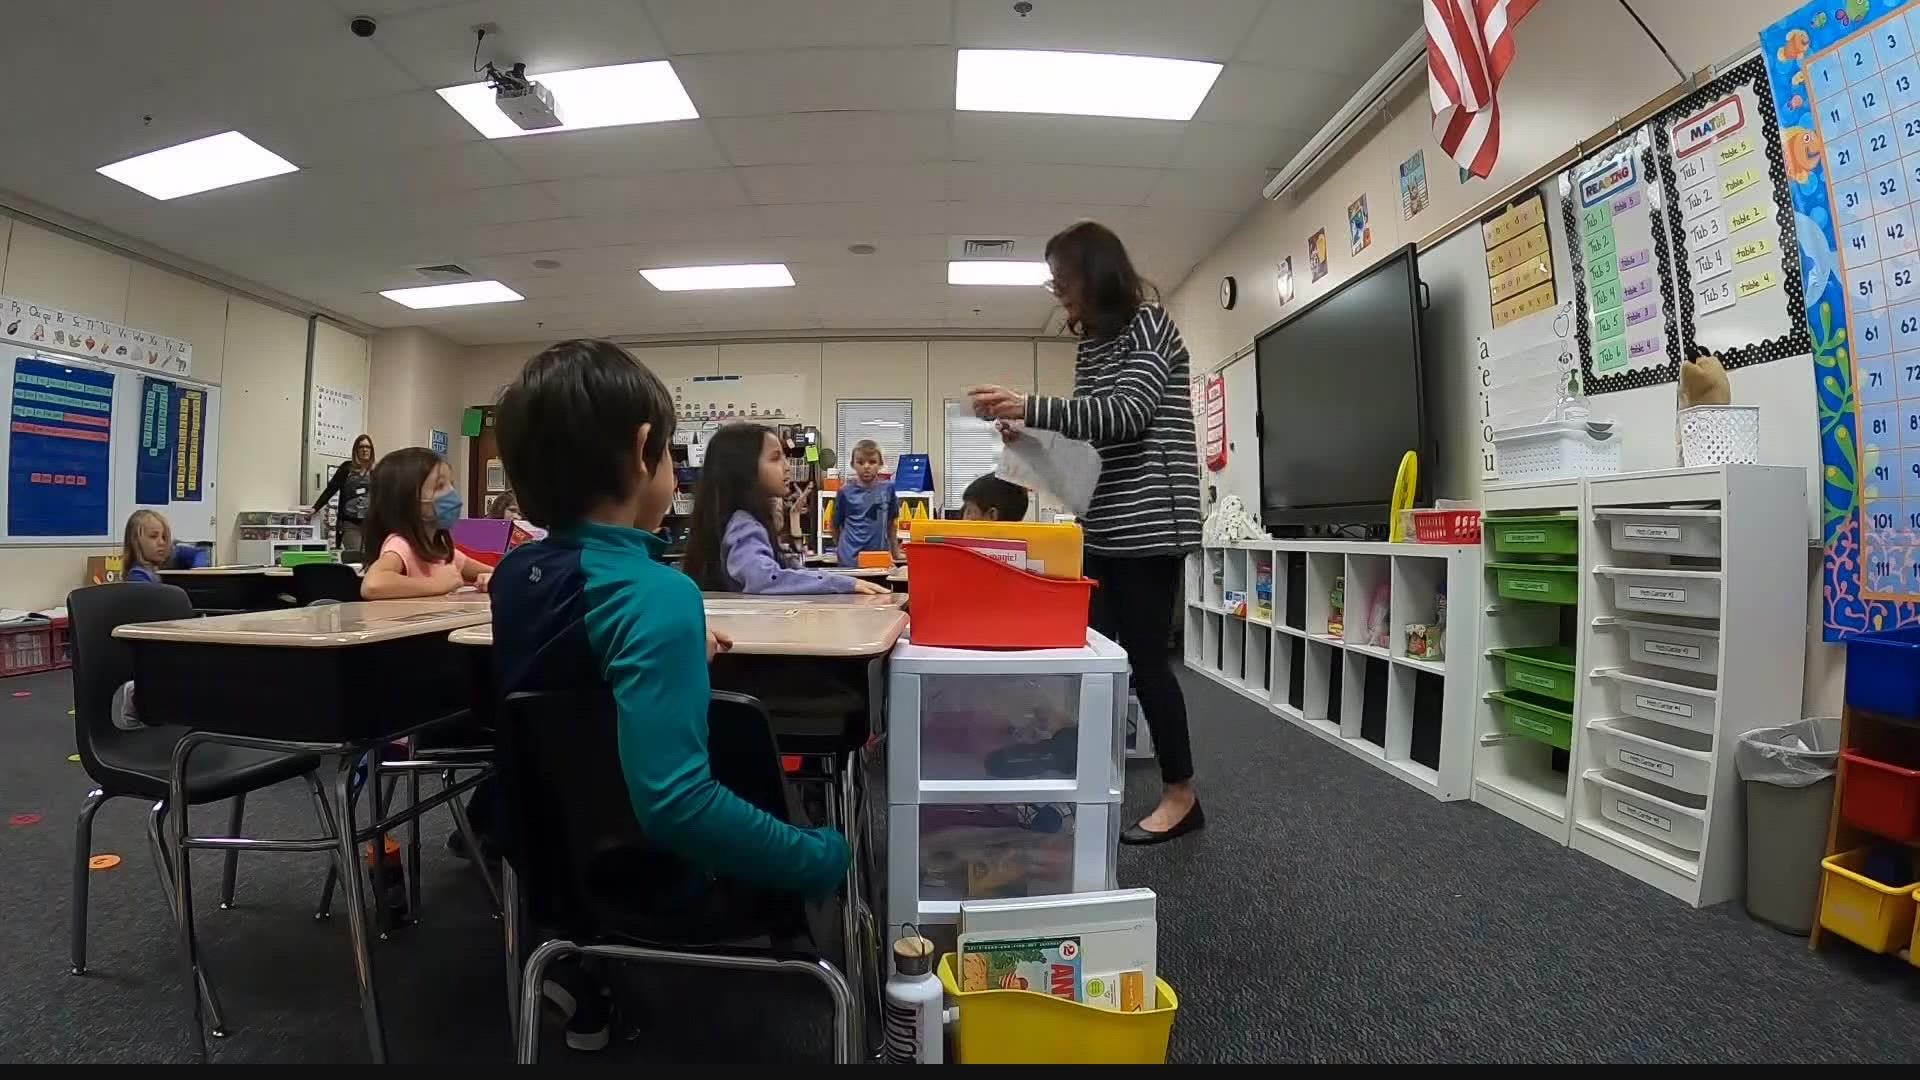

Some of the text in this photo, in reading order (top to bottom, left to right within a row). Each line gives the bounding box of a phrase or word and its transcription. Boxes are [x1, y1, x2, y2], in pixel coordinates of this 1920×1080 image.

[1824, 35, 1896, 81] 1 2 3
[1830, 76, 1910, 122] 11 12 13
[1690, 113, 1726, 141] MATH
[1720, 142, 1746, 160] table 5
[1838, 150, 1850, 166] 21
[1870, 134, 1886, 151] 22
[1680, 158, 1704, 180] Tub 1
[1586, 167, 1628, 197] READING
[1726, 178, 1744, 192] table
[1686, 189, 1712, 210] Tub 2
[1846, 178, 1896, 208] 31 32
[1584, 209, 1604, 229] Tub 1
[1732, 208, 1760, 227] table 2
[1690, 220, 1718, 242] Tub 3
[1852, 224, 1904, 250] 41 42
[1588, 236, 1609, 252] Tub 2
[1736, 241, 1764, 258] table 3
[1590, 261, 1610, 280] Tub 3
[1696, 250, 1722, 274] Tub 4
[1740, 273, 1769, 292] table 4
[1860, 270, 1911, 296] 51 52
[1594, 287, 1616, 306] Tub 4
[1700, 283, 1728, 305] Tub 5
[1597, 314, 1618, 334] Tub 5
[1865, 317, 1918, 341] 61 62
[1480, 342, 1490, 360] a
[1600, 346, 1621, 364] Tub 6
[1482, 369, 1491, 386] e
[1870, 365, 1920, 387] 71 72
[1486, 396, 1490, 417] i
[1484, 425, 1494, 442] o
[1873, 419, 1886, 434] 81
[1484, 454, 1494, 472] u
[1875, 466, 1888, 480] 91
[1873, 514, 1892, 528] 101
[1876, 562, 1890, 576] 111
